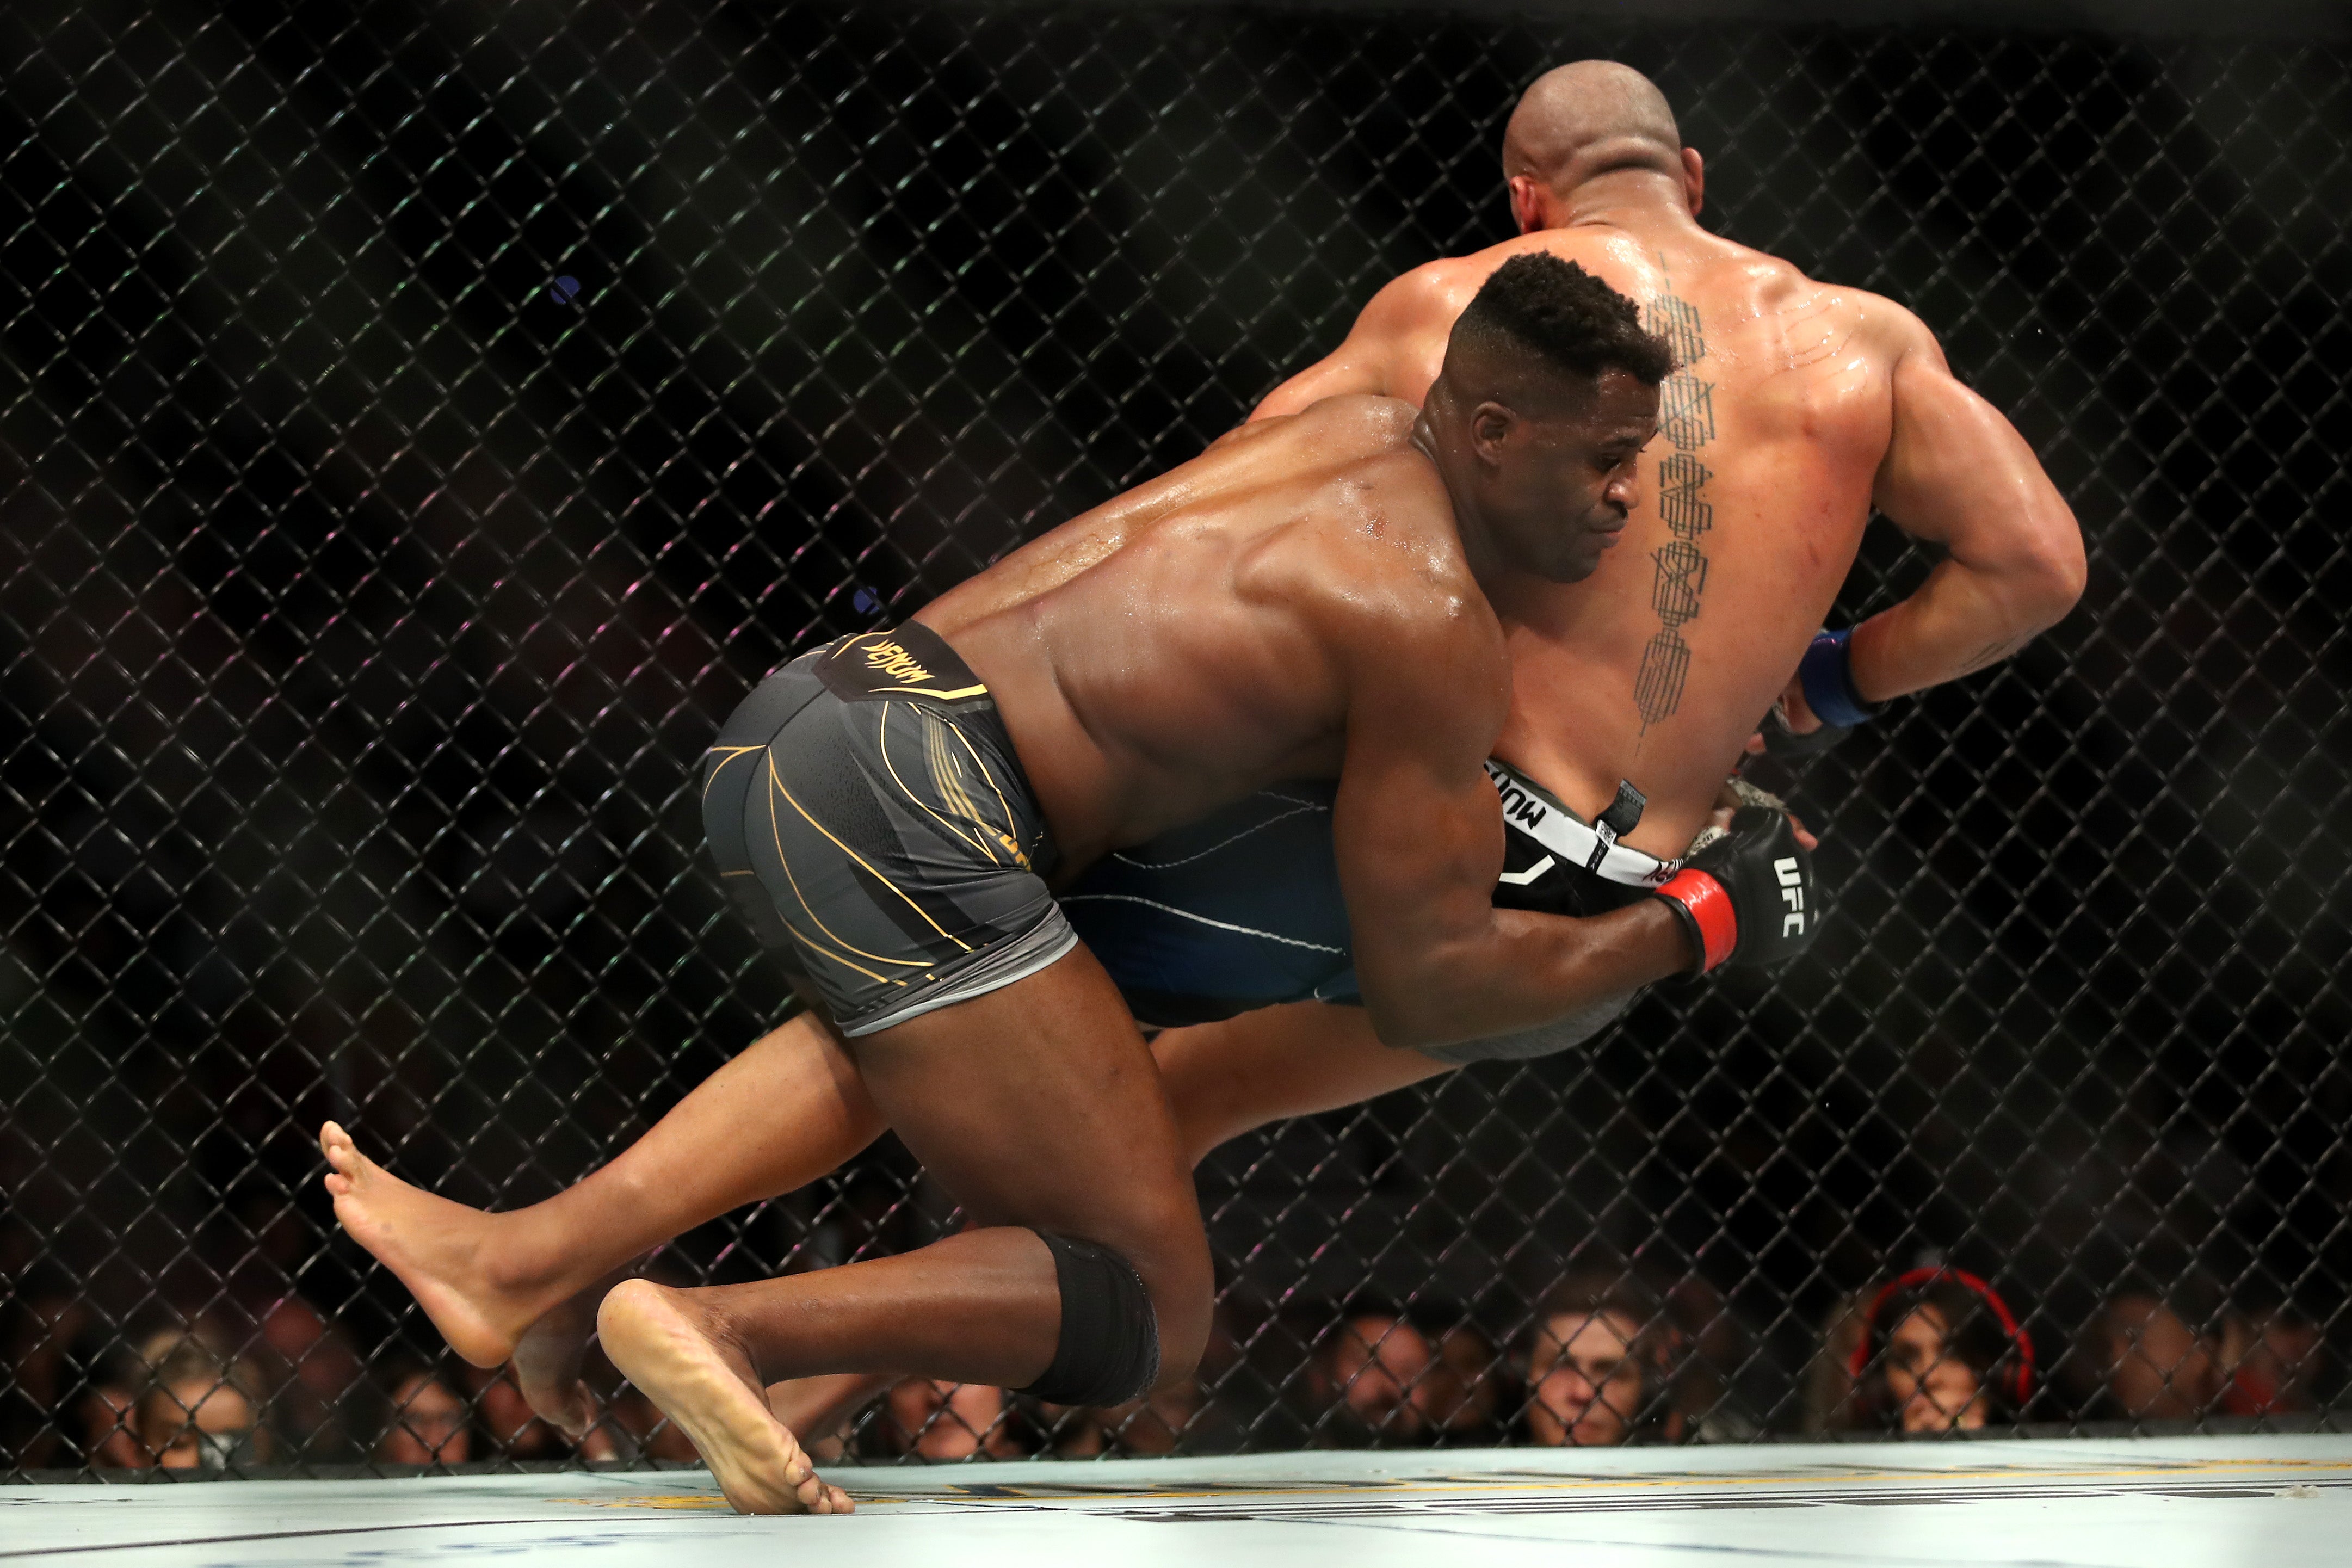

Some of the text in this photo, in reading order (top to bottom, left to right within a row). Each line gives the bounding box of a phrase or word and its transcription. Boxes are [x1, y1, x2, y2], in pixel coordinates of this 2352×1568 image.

[861, 639, 935, 683] VENUM
[999, 834, 1032, 872] UF
[1774, 857, 1804, 937] UFC
